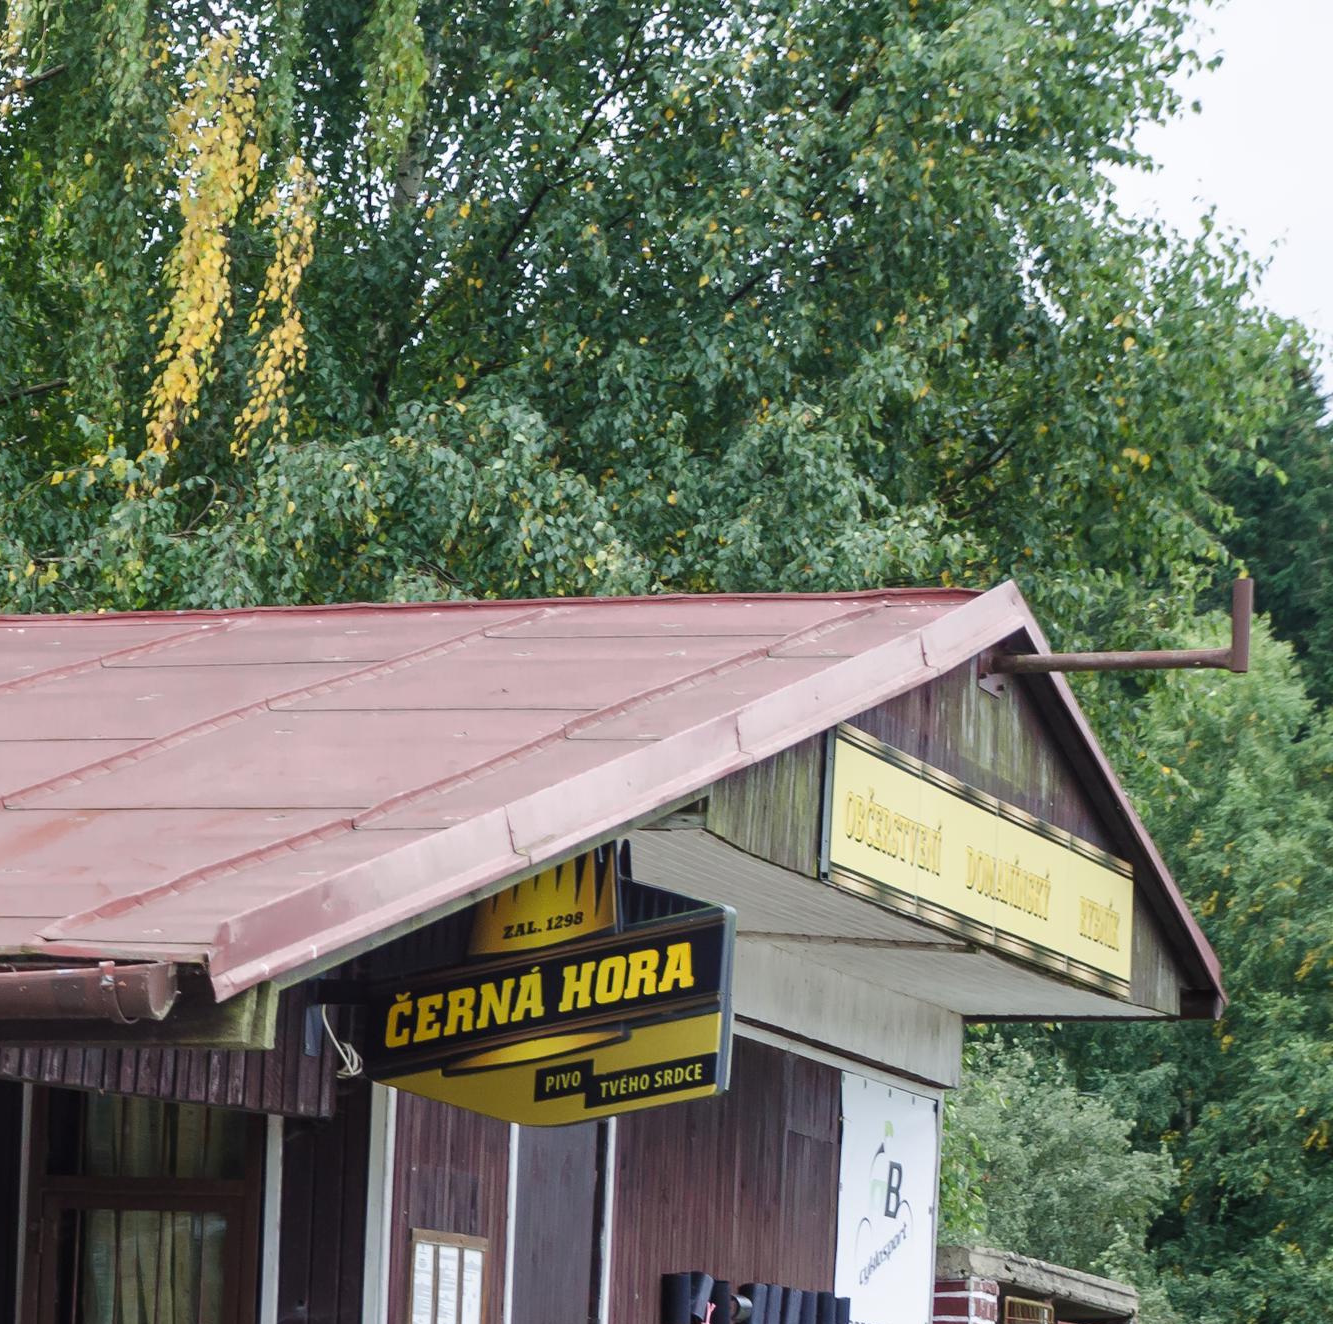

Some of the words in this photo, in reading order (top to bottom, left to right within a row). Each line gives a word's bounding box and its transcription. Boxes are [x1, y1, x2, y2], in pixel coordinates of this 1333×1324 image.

[502, 918, 543, 940] ZAL.
[545, 911, 585, 933] 1298
[383, 966, 545, 1050] ČERNÁ
[557, 941, 695, 1014] HORA
[545, 1069, 582, 1094] PIVO
[599, 1071, 652, 1099] TVÉHO
[653, 1062, 704, 1092] SRDCE
[859, 1221, 908, 1286] cyklosport
